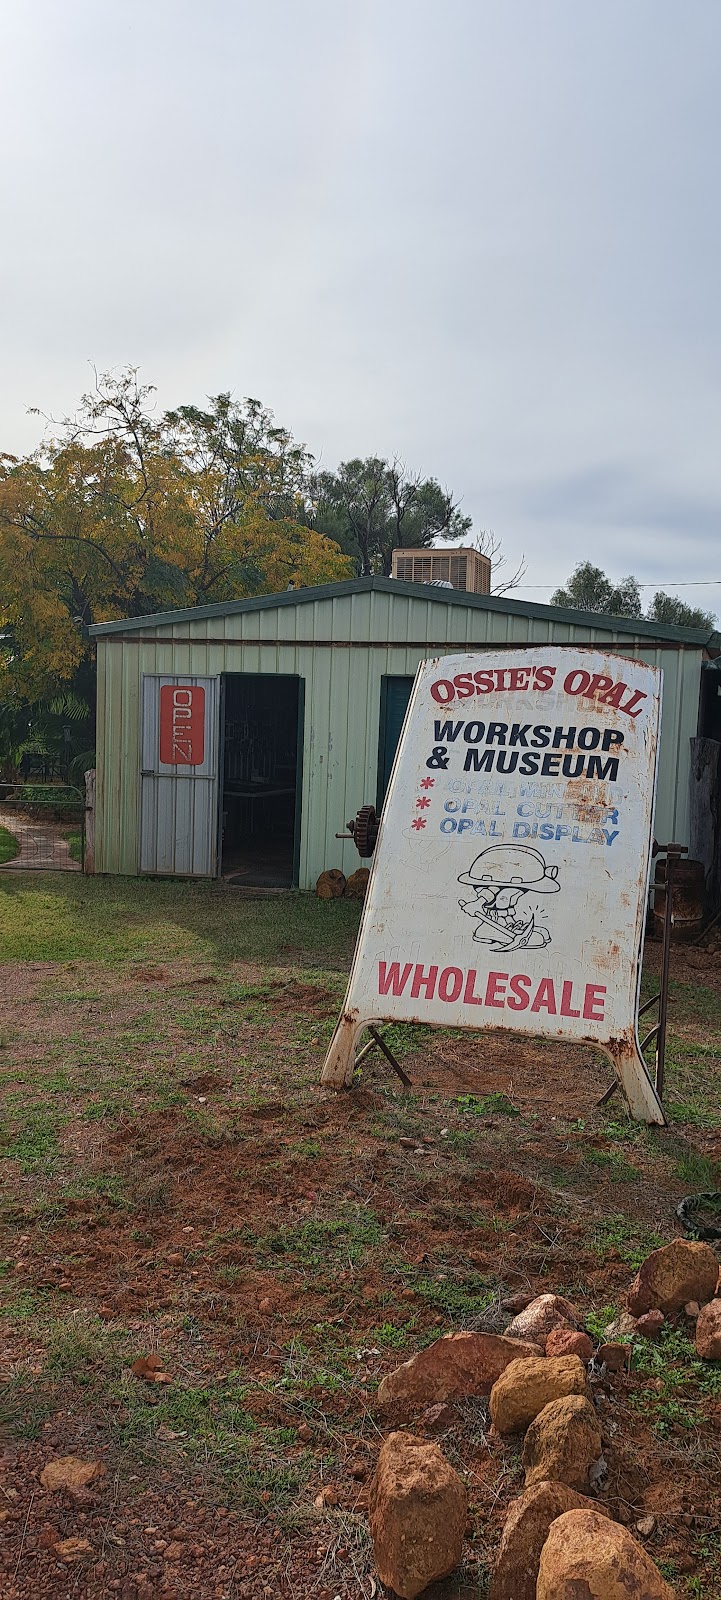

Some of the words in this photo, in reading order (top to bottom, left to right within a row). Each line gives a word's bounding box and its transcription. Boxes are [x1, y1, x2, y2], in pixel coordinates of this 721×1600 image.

[430, 666, 557, 704] OSSIE'S
[563, 669, 648, 718] OPAL
[173, 689, 192, 761] OPEN
[433, 720, 625, 751] WORKSHOP
[426, 746, 450, 770] &
[463, 748, 620, 781] MUSEUM
[443, 798, 506, 816] OPAL
[516, 801, 619, 825] CUTTR
[439, 817, 502, 836] OPAL
[512, 821, 620, 847] DISPLAY
[378, 961, 607, 1021] WHOLESALE
